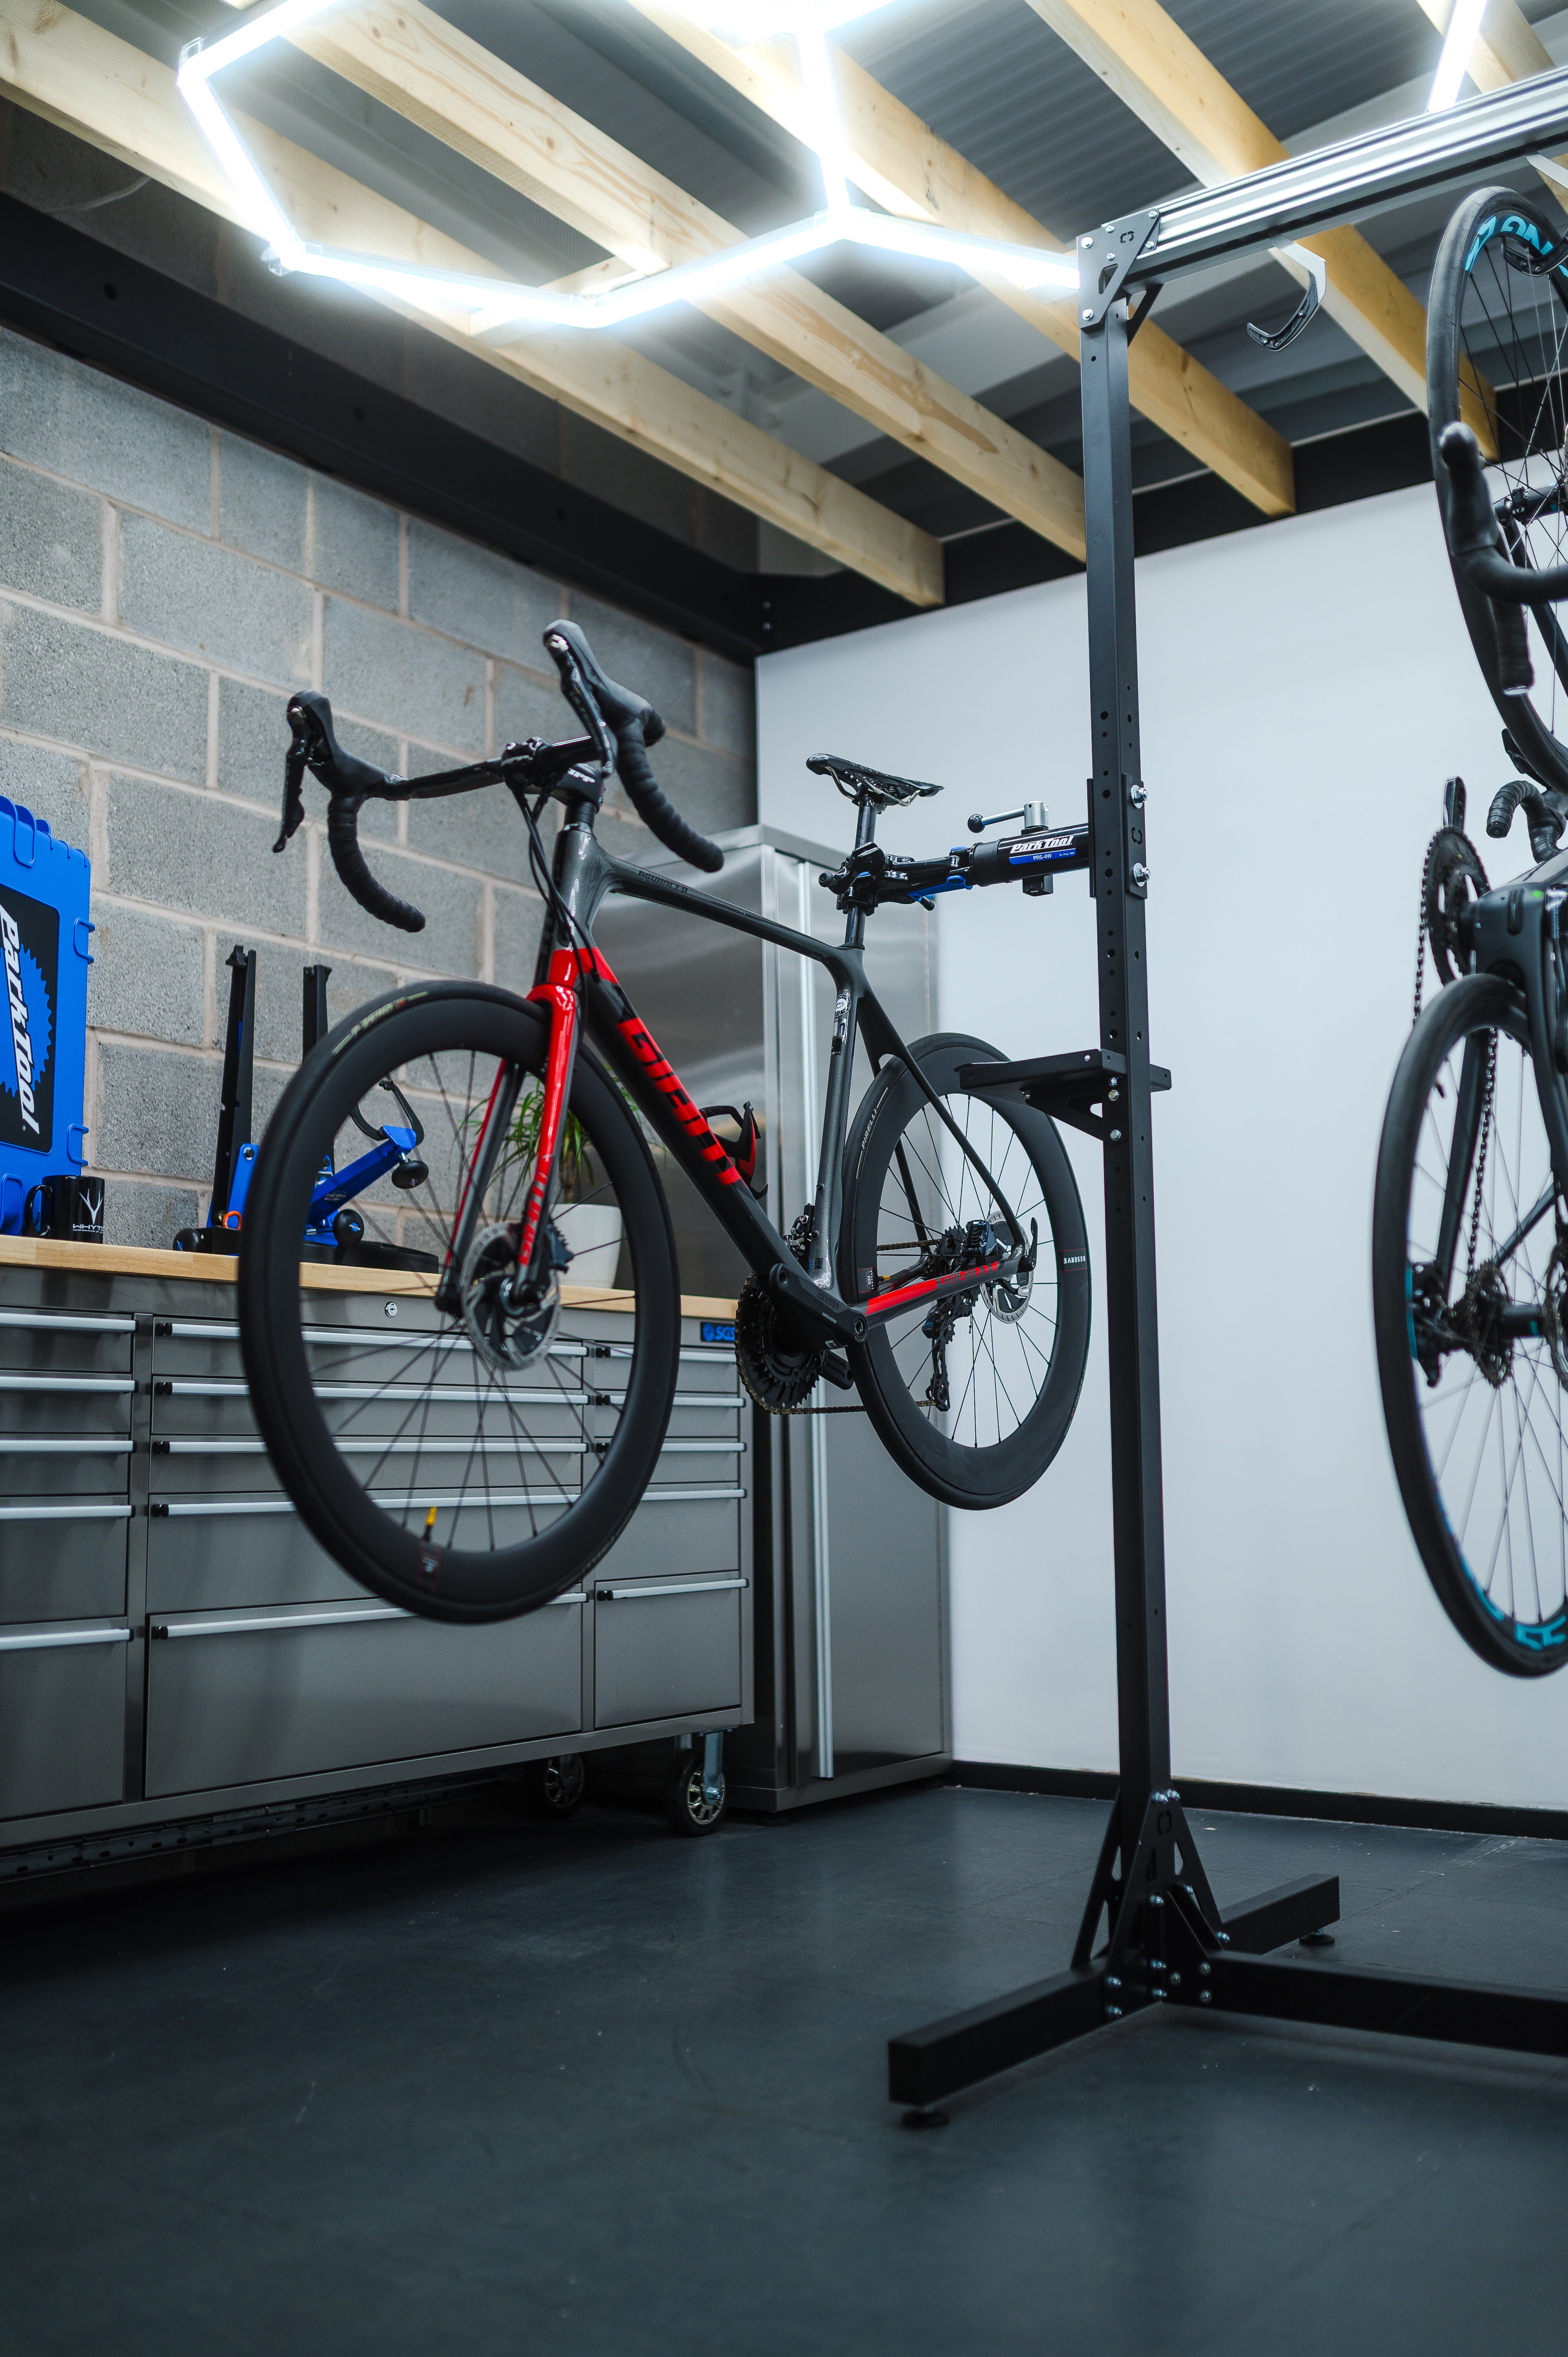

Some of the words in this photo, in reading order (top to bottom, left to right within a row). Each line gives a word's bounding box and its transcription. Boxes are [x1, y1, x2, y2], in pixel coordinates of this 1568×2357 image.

[862, 1108, 877, 1150] PIRELLI
[1063, 1255, 1086, 1264] RESERVE
[822, 1312, 837, 1324] ROTOR
